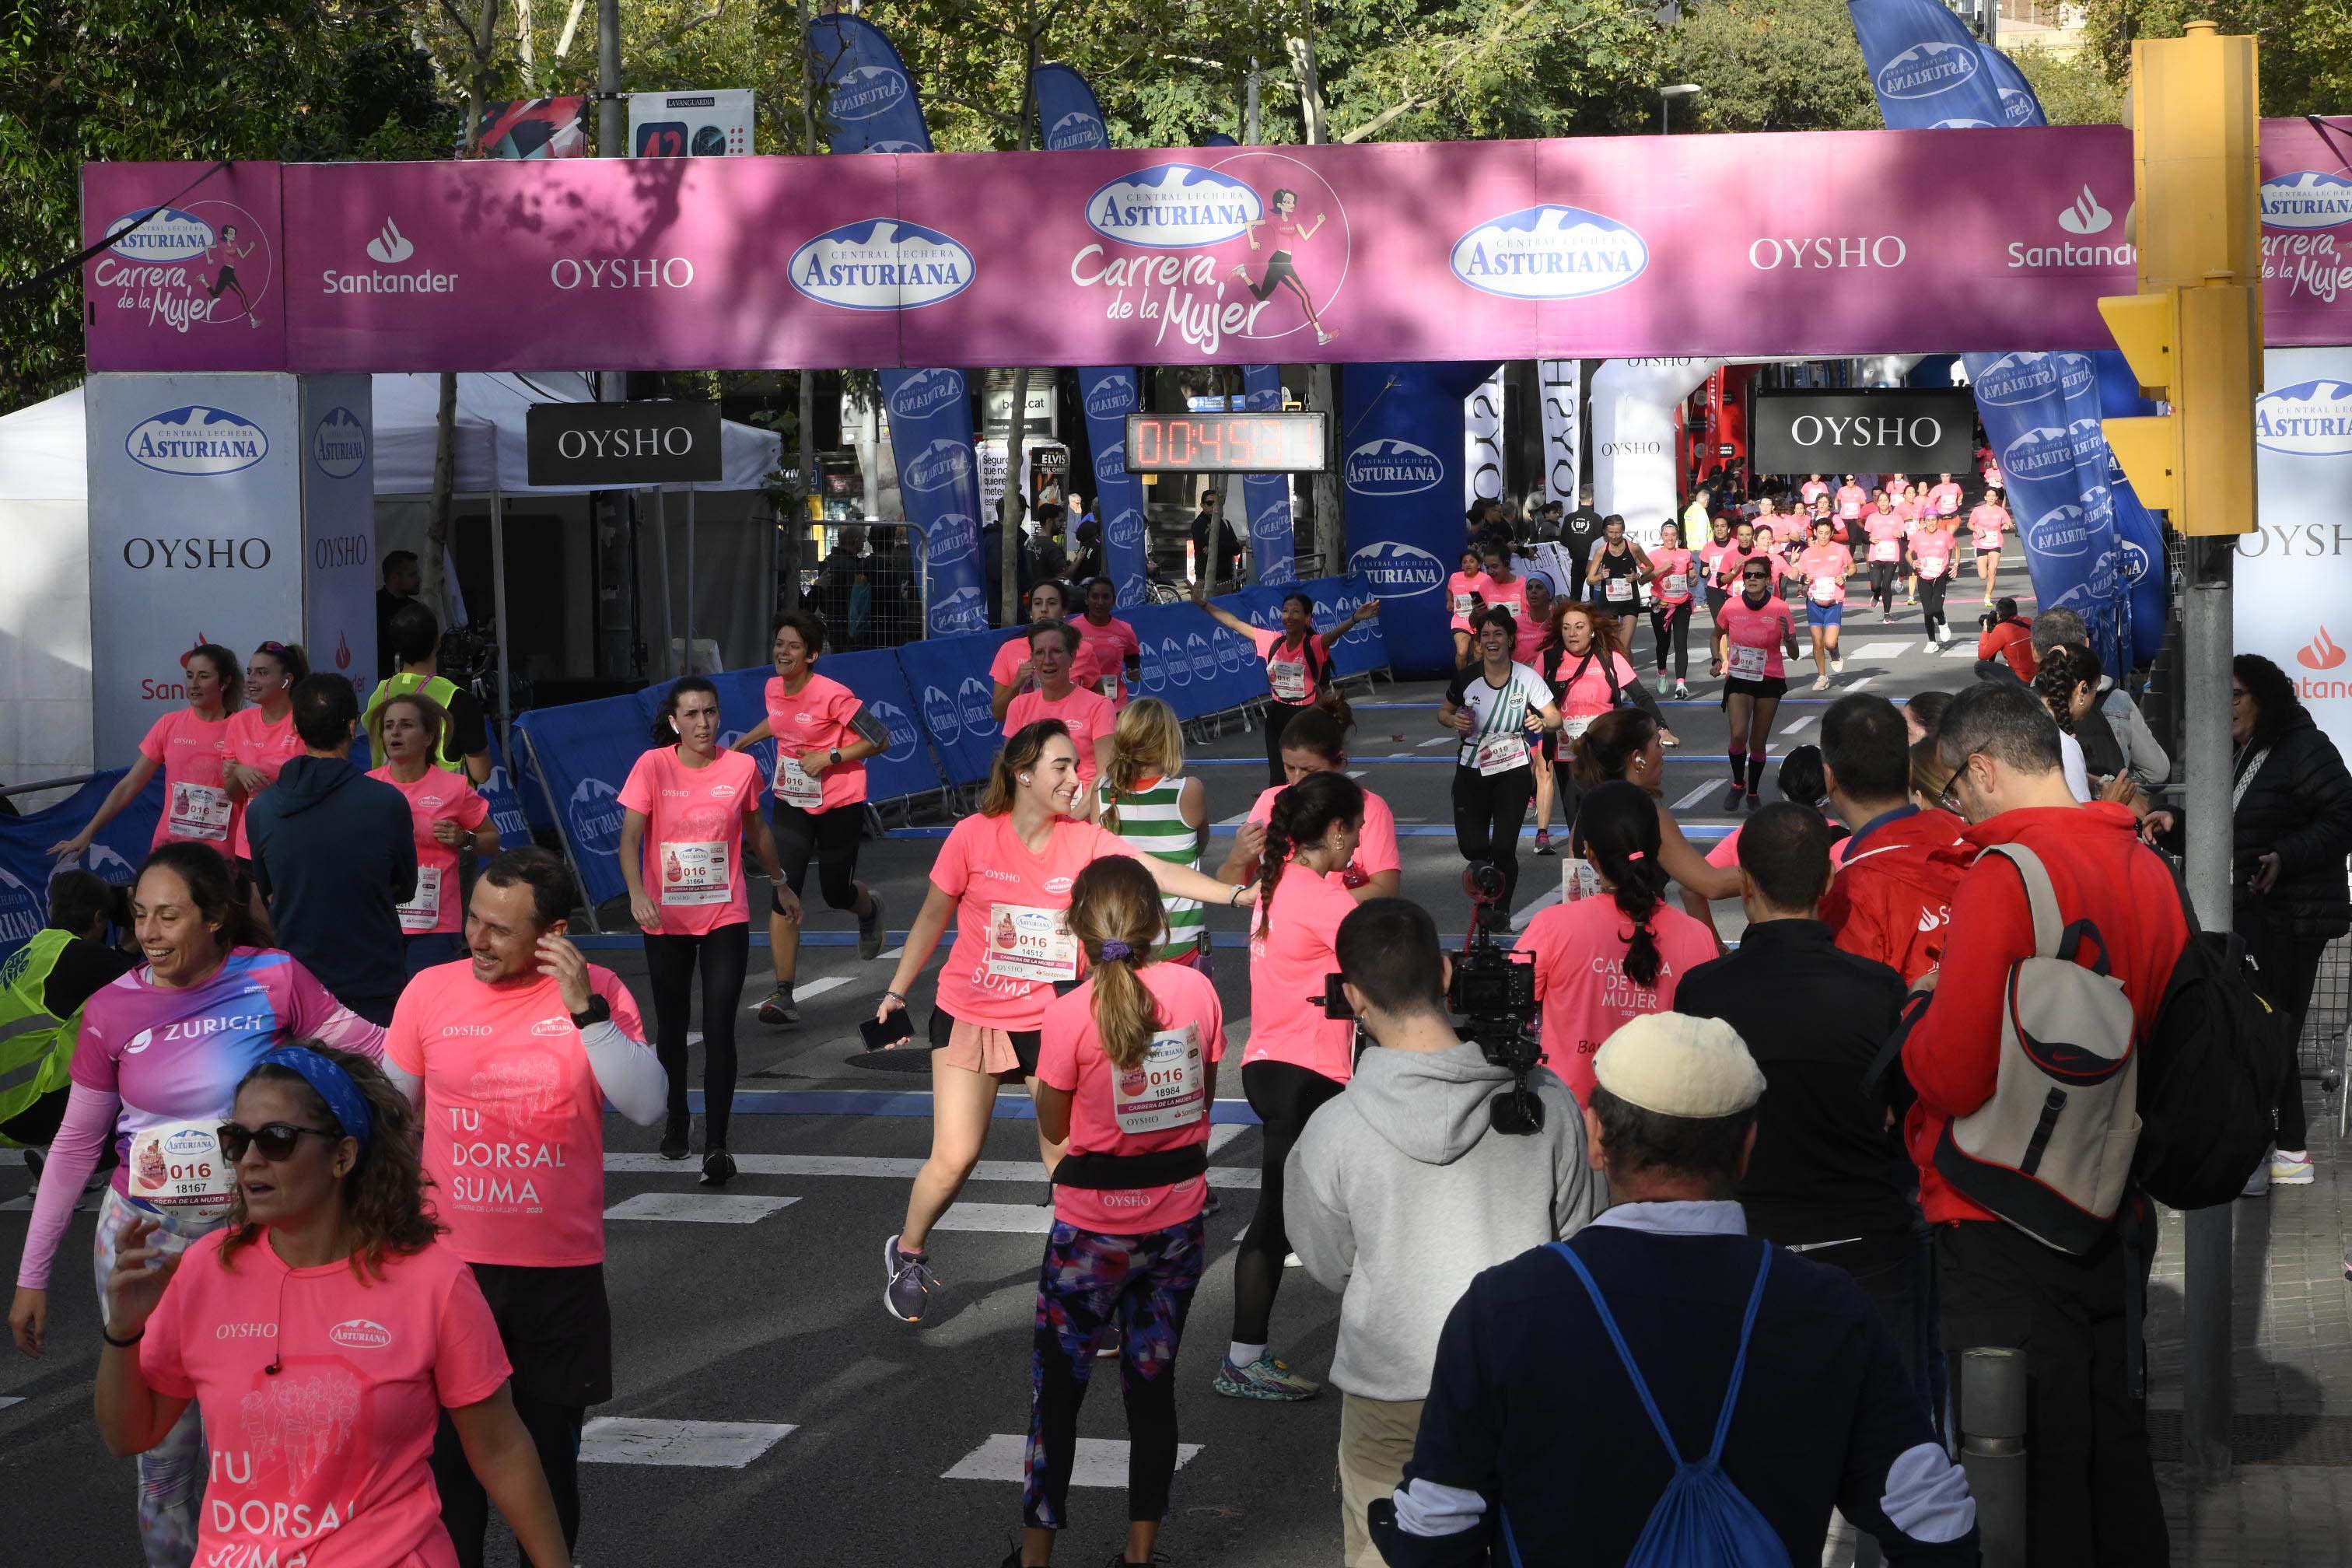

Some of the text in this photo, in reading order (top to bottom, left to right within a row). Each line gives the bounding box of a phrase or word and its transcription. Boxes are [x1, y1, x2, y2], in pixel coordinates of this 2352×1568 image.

[1126, 191, 1244, 202] CENTRAL LECHERA
[2272, 191, 2313, 199] CENTRAL
[1099, 194, 1248, 229] ASTURIANA
[114, 226, 208, 250] ASTURIANA
[2260, 233, 2336, 256] arrera
[831, 249, 956, 261] CENTRAL LECHERA
[1465, 240, 1633, 278] ASTURIANA
[1748, 235, 1908, 271] OYSHO
[2007, 241, 2138, 268] Santand
[94, 257, 187, 288] Carrera
[550, 257, 695, 290] OYSHO
[802, 252, 962, 287] ASTURIANA
[1070, 243, 1217, 288] Carrera
[2280, 256, 2293, 278] la
[324, 269, 459, 294] Santander
[117, 284, 221, 333] de la Mujer
[1106, 281, 1272, 355] de la Mujer
[1791, 415, 1941, 447] OYSHO
[136, 431, 258, 459] ASTURIANA
[317, 433, 363, 462] ASTURIANA
[558, 427, 693, 459] OYSHO
[1601, 441, 1661, 457] OYSHO
[1041, 455, 1066, 464] ELVIS
[1349, 462, 1436, 484] ASTURIANA
[123, 537, 271, 569] OYSHO
[315, 534, 367, 569] OYSHO
[1493, 746, 1508, 754] 016
[786, 777, 803, 786] 016
[661, 789, 689, 797] OYSHO
[191, 805, 210, 815] 016
[684, 866, 706, 877] 016
[985, 870, 1020, 884] OYSHO
[1020, 935, 1048, 948] 016
[1022, 948, 1044, 957] 14512
[996, 964, 1023, 973] OYSHO
[1042, 971, 1069, 979] Santander
[971, 967, 1031, 996] SUMA
[1607, 975, 1629, 992] DE
[1601, 991, 1657, 1009] MUJER
[163, 1014, 263, 1042] ZURICH
[442, 1026, 492, 1037] OYSHO
[1150, 1067, 1183, 1085] 016
[1155, 1086, 1180, 1097] 18984
[1129, 1101, 1157, 1111] CARRERA
[1175, 1095, 1192, 1104] MUJER
[448, 1107, 480, 1132] TU
[1126, 1115, 1159, 1126] OYSHO
[168, 1140, 212, 1150] ASTURIANA
[452, 1142, 566, 1168] DORSAL
[170, 1163, 212, 1180] 016
[175, 1183, 207, 1194] 18167
[452, 1174, 541, 1205] SUMA
[1104, 1195, 1151, 1207] OYSHO
[216, 1322, 278, 1339] OYSHO
[334, 1328, 387, 1344] ASTURIANA
[212, 1450, 250, 1484] TU
